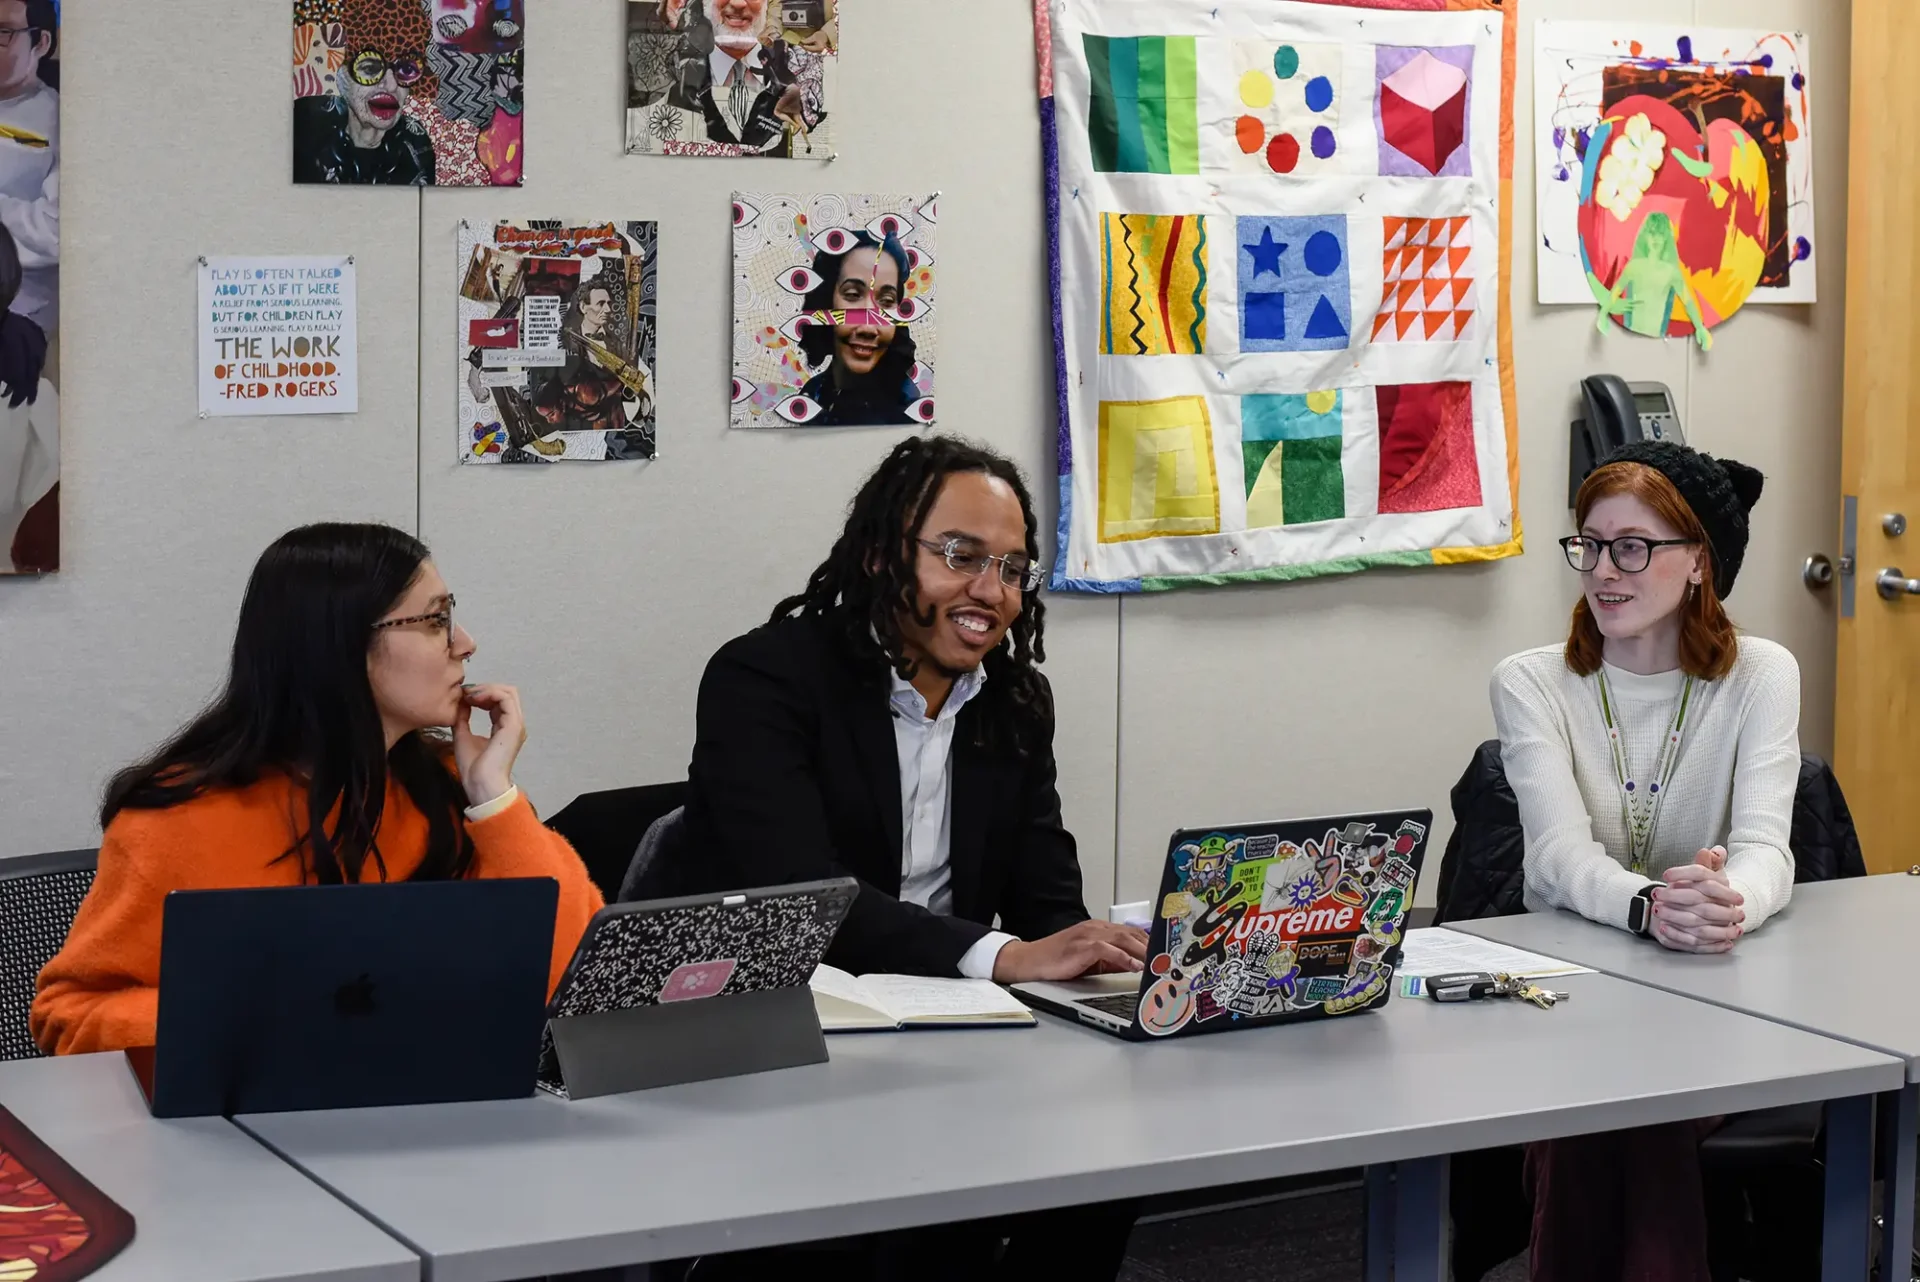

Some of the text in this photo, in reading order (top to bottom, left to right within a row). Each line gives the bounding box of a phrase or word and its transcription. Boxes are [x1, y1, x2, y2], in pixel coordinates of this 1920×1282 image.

[497, 221, 615, 248] Change is good
[211, 268, 342, 280] PLAY IS OFTEN TALKED
[215, 283, 340, 296] ABOUT AS IF IT WERE
[212, 300, 218, 308] A
[219, 300, 245, 308] RELIEF
[246, 299, 269, 307] FROM
[270, 299, 301, 307] SERIOUS
[212, 310, 343, 322] BUT FOR CHILDREN PLAY
[220, 325, 249, 333] SERIOUS
[288, 324, 306, 332] PLAY
[307, 324, 313, 332] IS
[314, 324, 342, 332] REALLY
[214, 335, 341, 359] THE WORK
[214, 361, 341, 380] OF CHILDHOOD.
[220, 381, 338, 399] -FRED ROGERS
[1403, 822, 1423, 835] SCHOOL
[1240, 866, 1261, 877] DON'T
[1249, 883, 1258, 892] TO
[1379, 901, 1393, 911] ON
[1216, 906, 1355, 940] upreme
[1312, 979, 1342, 988] VIRTUAL
